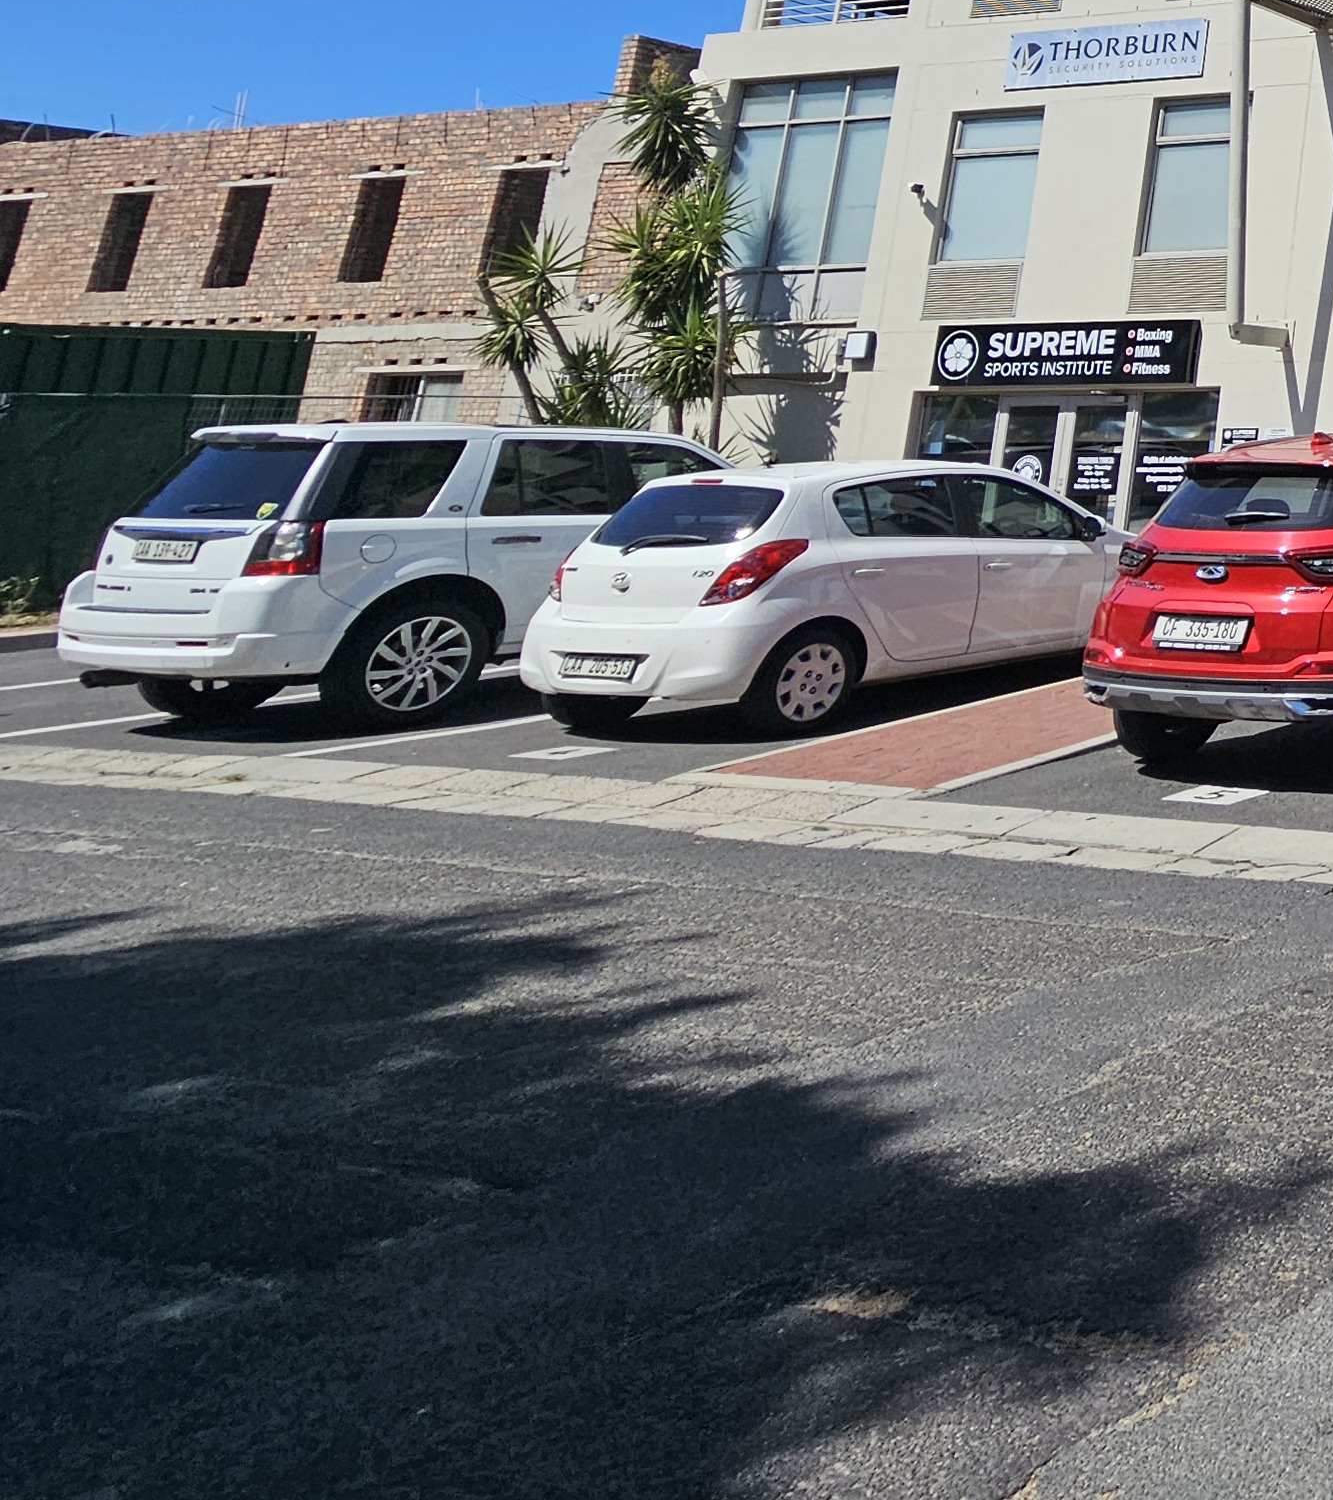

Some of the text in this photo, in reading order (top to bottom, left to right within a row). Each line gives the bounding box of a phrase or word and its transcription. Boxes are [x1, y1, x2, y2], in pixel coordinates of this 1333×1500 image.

[1049, 30, 1201, 62] THORBURN
[1048, 55, 1197, 75] SECURITY SOLUTIONS
[987, 329, 1117, 358] SUPREME
[1136, 328, 1173, 342] Boxing
[1134, 345, 1161, 358] MMA
[984, 361, 1113, 378] SPORTS INSTITUTE
[1131, 363, 1171, 375] Fitness
[1162, 618, 1239, 640] CF 335-180
[563, 655, 632, 675] CAA 205-513
[1194, 789, 1240, 800] 5
